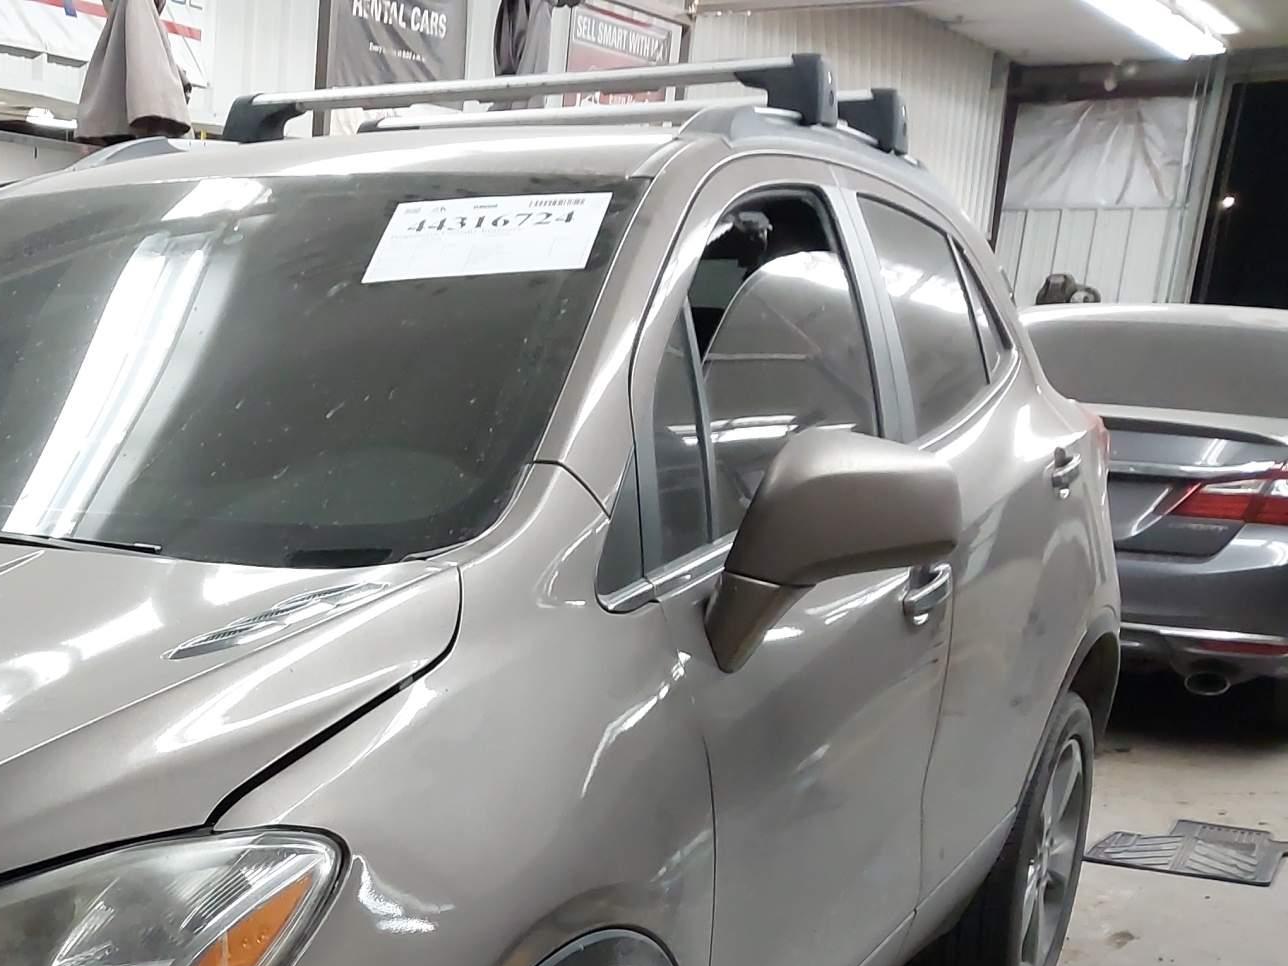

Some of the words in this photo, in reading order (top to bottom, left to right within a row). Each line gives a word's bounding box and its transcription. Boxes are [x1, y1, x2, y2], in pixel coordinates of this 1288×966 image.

[352, 0, 406, 29] RENTAL
[411, 6, 447, 39] CARS
[576, 15, 596, 42] SELL
[597, 22, 629, 50] SMART
[629, 30, 650, 56] WITH
[407, 210, 575, 233] 44316724
